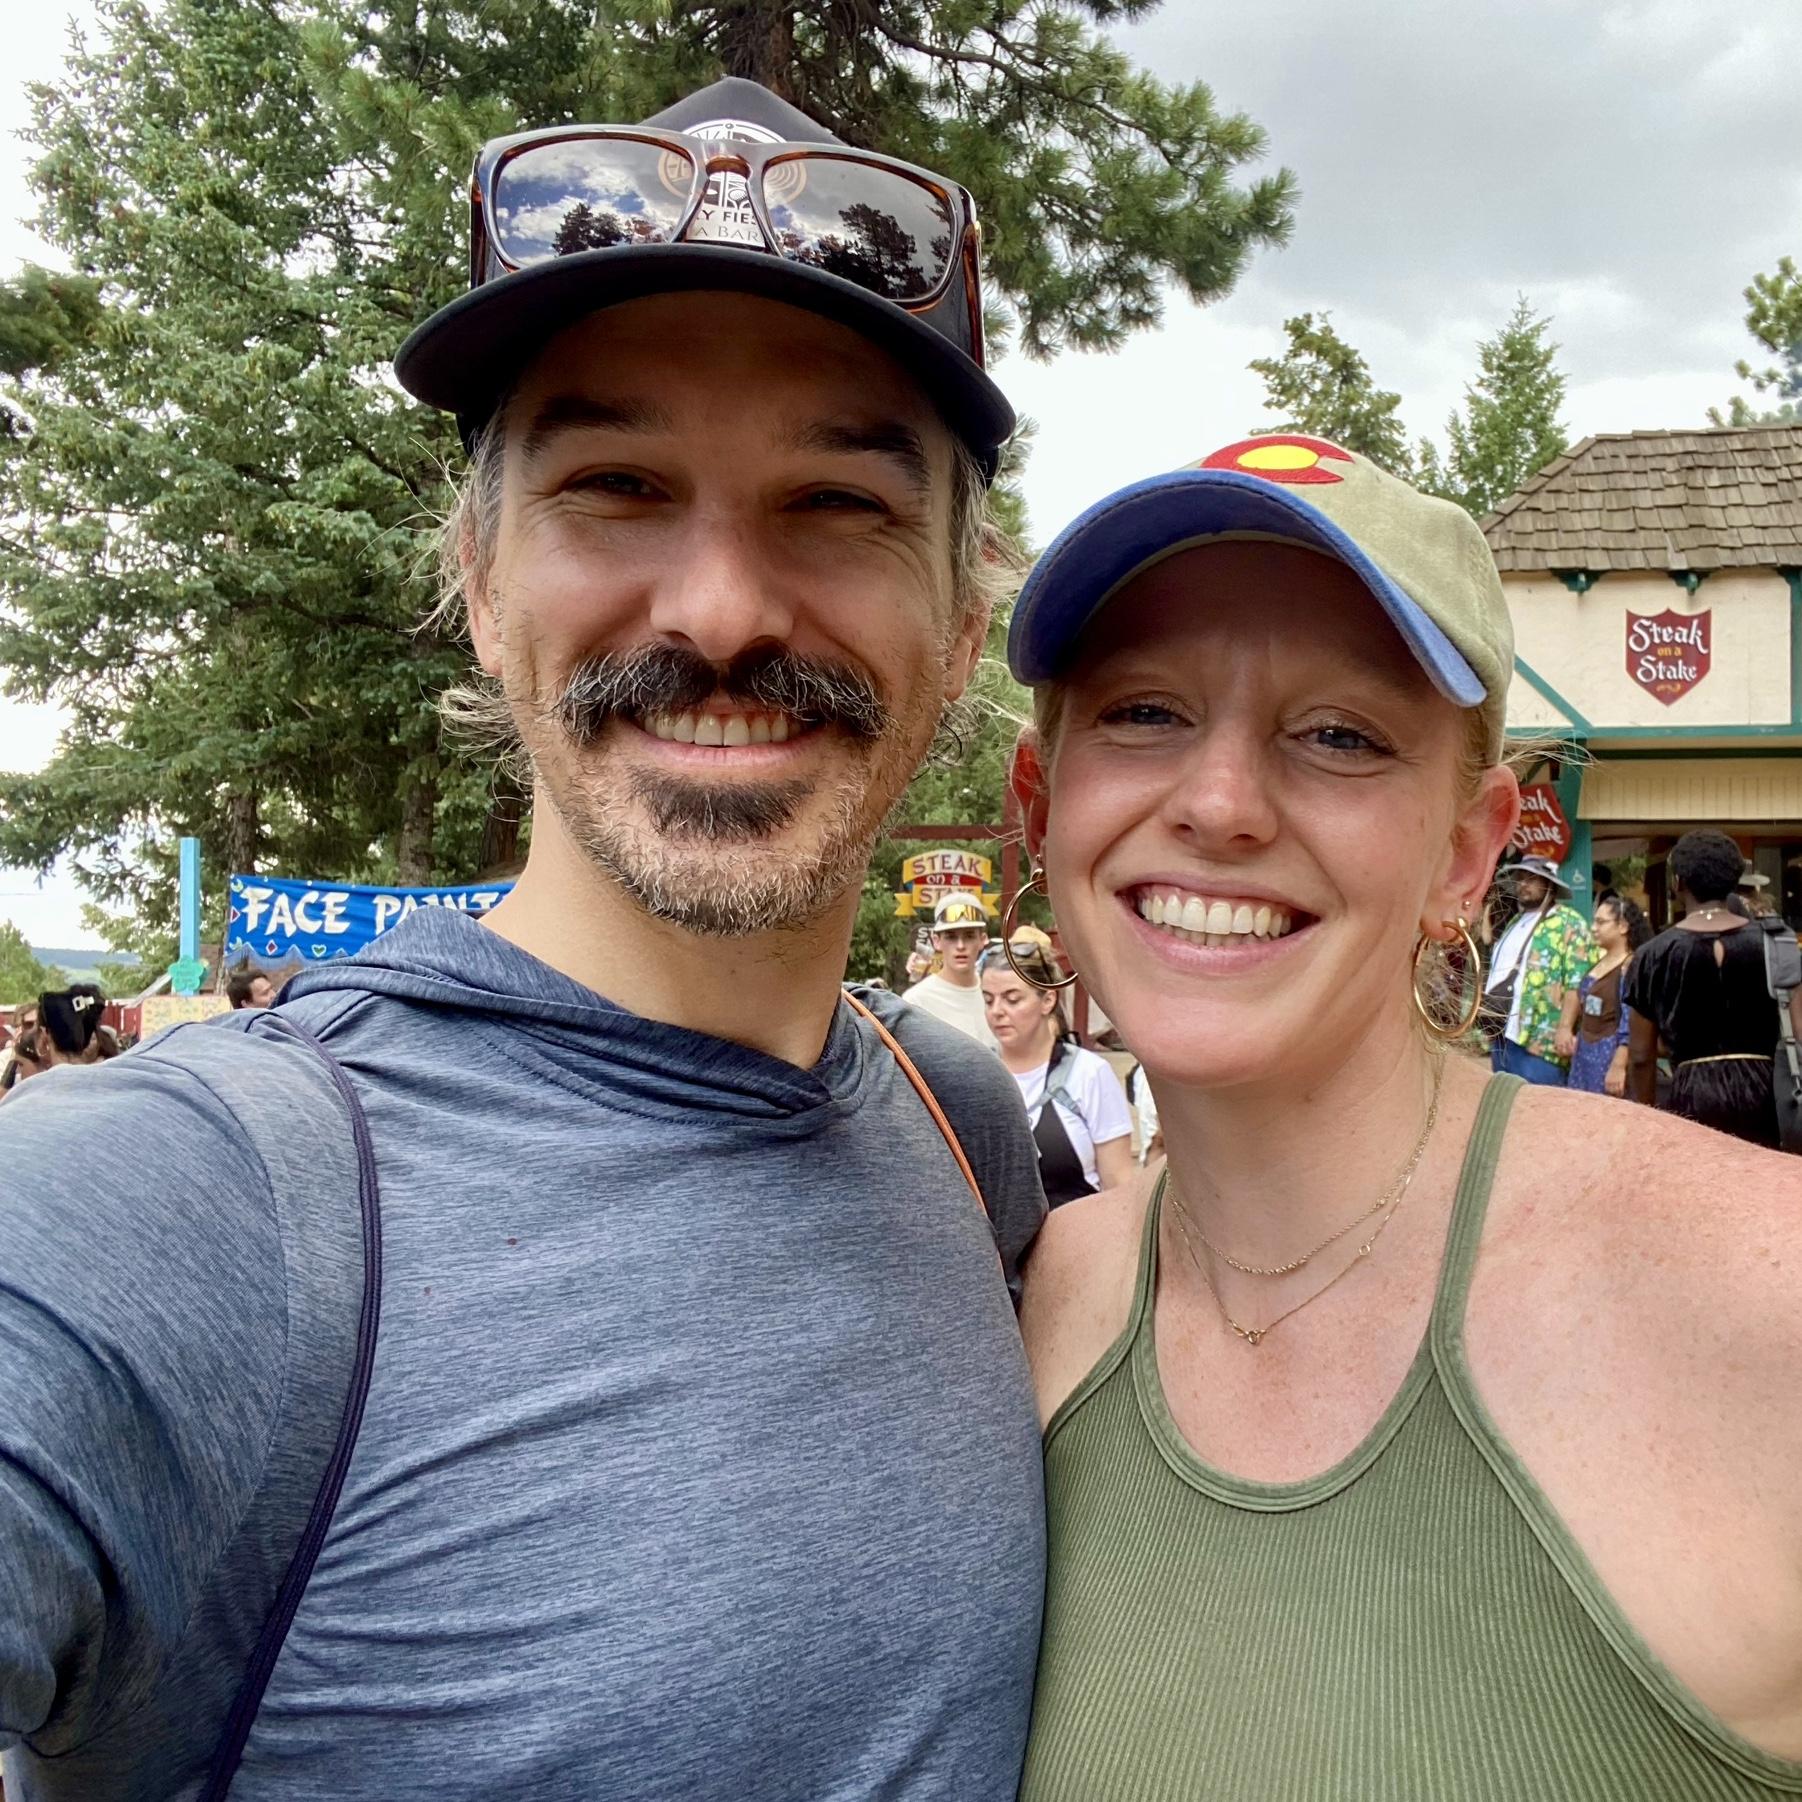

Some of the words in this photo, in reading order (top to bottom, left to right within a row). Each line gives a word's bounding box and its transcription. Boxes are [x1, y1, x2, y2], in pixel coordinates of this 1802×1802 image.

[1628, 618, 1709, 654] Steak
[1657, 647, 1672, 656] on
[1674, 646, 1682, 656] a
[1636, 654, 1698, 683] Stake
[1520, 788, 1562, 824] eak
[912, 854, 983, 877] STEAK
[926, 874, 945, 885] on
[240, 887, 350, 937] FACE
[372, 892, 500, 935] PAT
